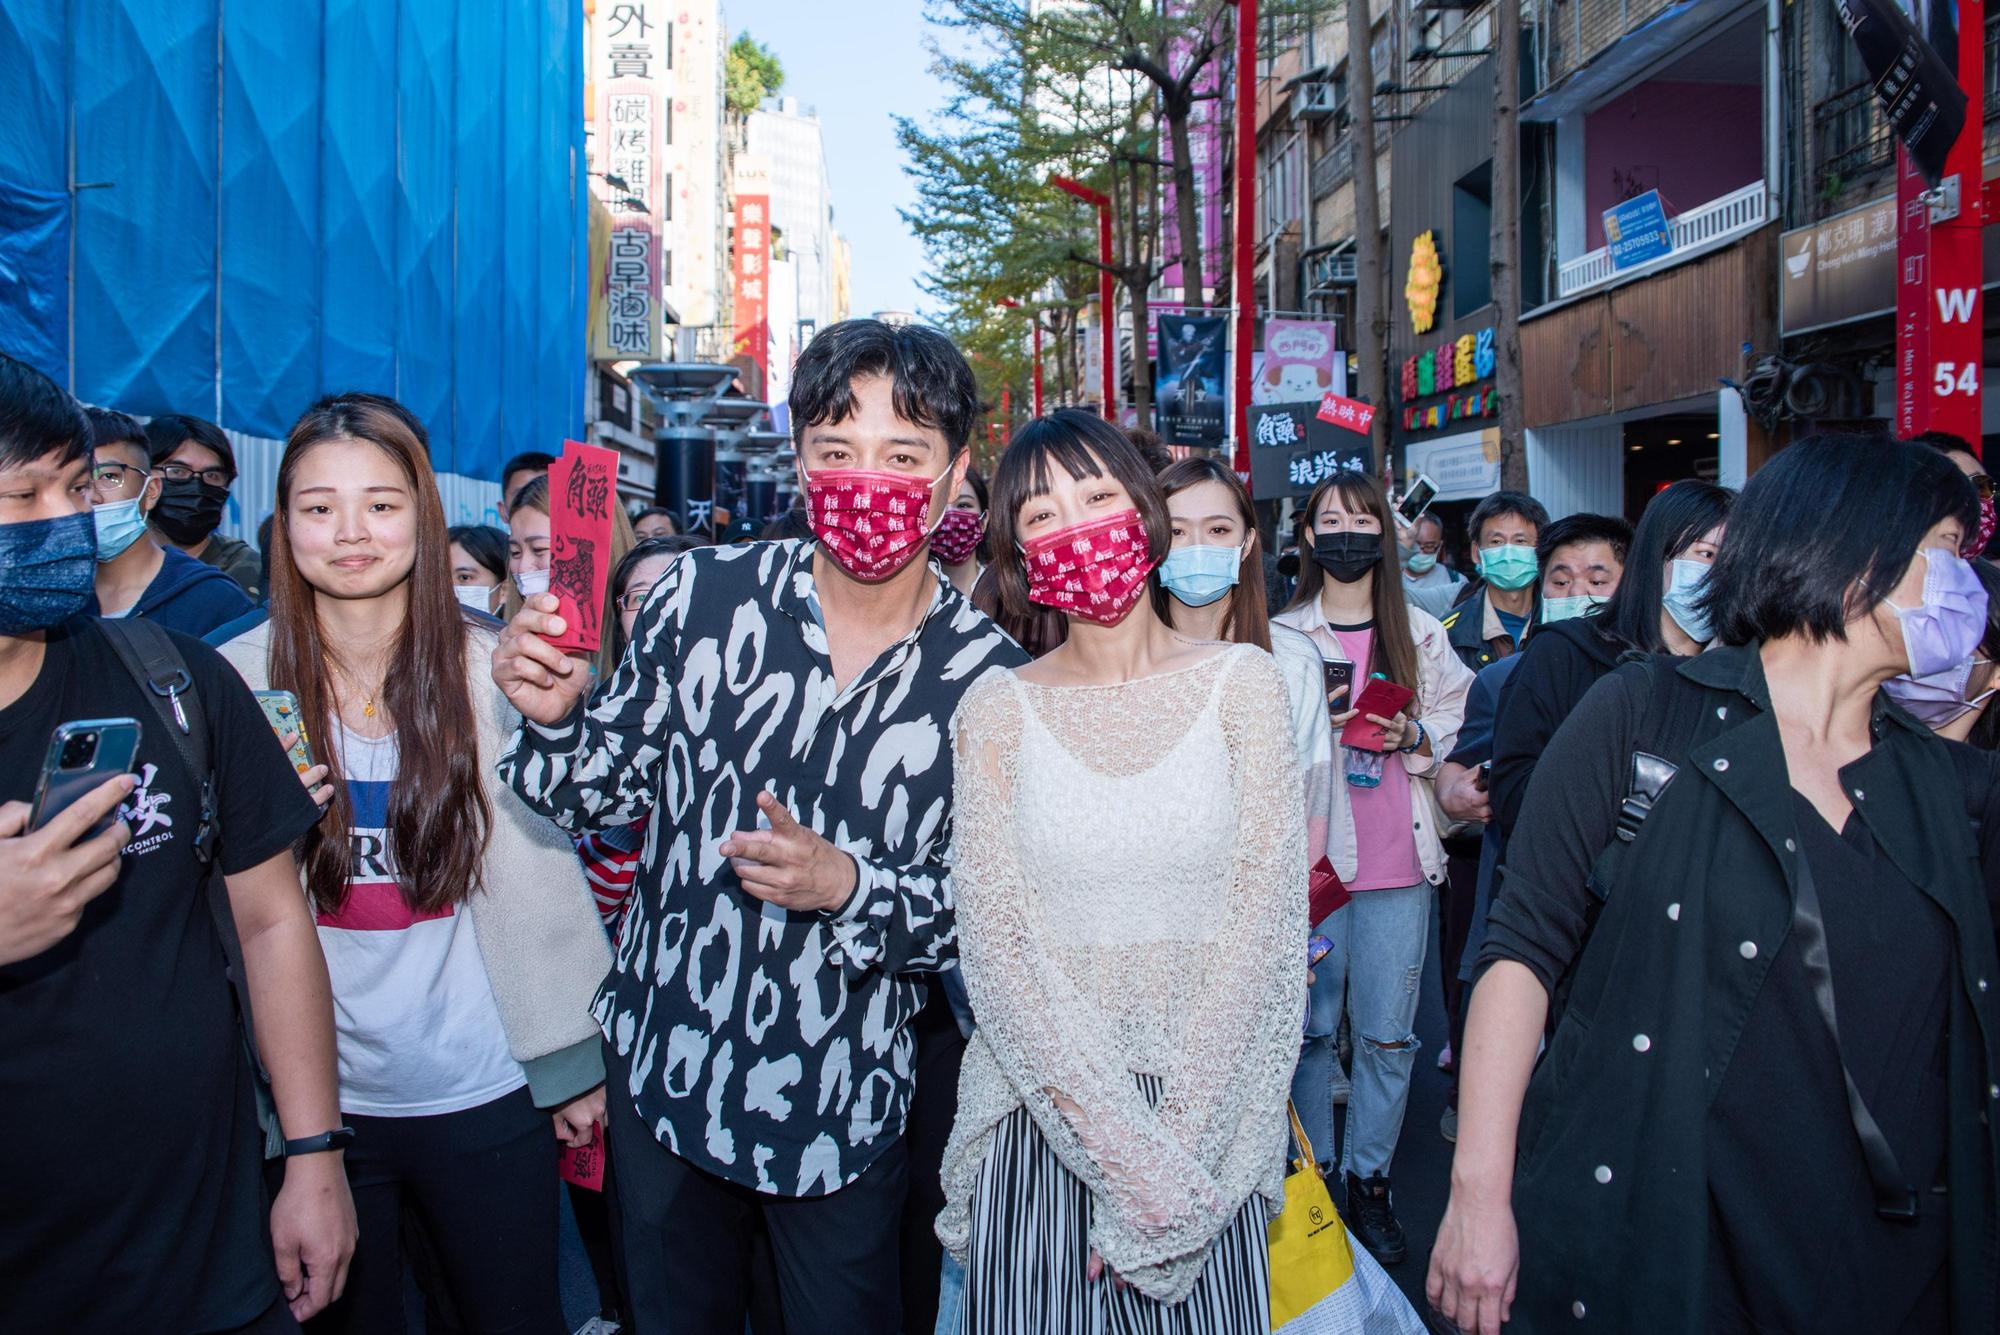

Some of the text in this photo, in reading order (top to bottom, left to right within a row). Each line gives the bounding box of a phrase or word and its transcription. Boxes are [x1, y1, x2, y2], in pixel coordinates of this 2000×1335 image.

[607, 4, 654, 79] 外賣
[609, 229, 651, 351] 古早滷味
[1936, 288, 1977, 323] W
[1934, 362, 1978, 396] 54
[1319, 397, 1372, 427] 熱映中
[1256, 413, 1298, 446] 角頭
[566, 456, 608, 521] 角頭
[687, 498, 713, 532] 天
